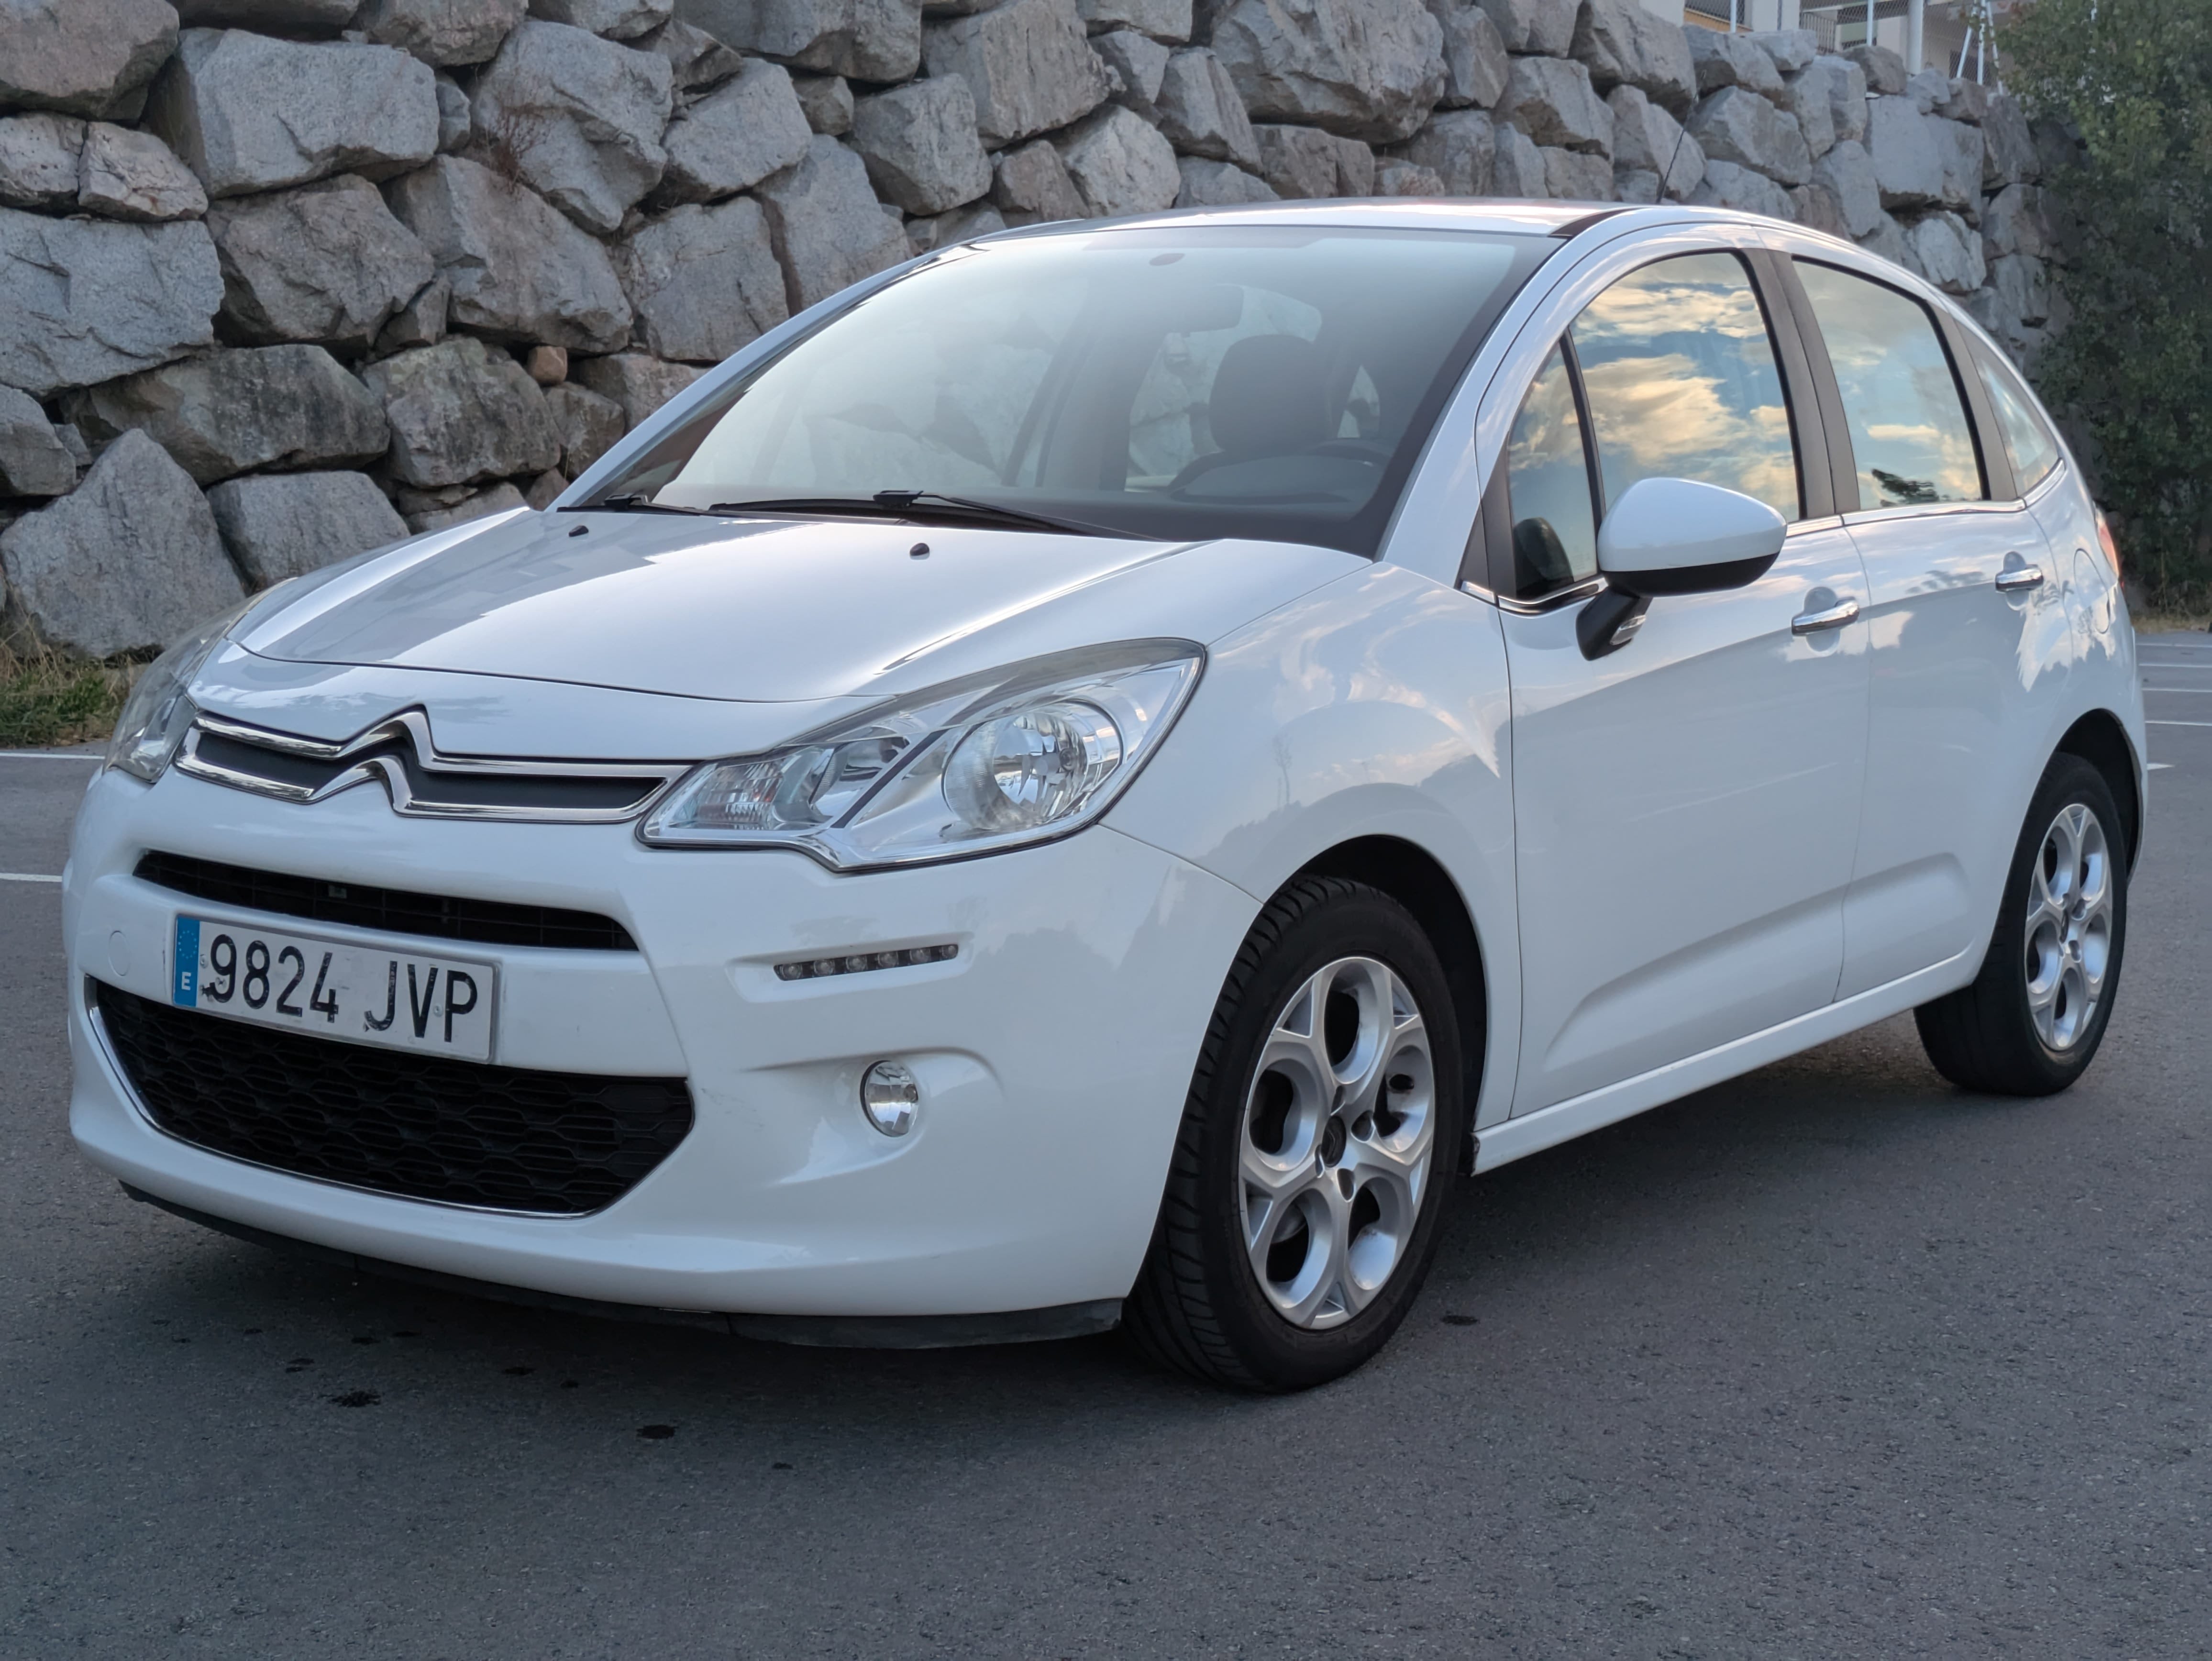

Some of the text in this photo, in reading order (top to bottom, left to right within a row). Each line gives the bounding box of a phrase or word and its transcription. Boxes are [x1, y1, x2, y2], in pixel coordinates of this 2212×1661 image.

[181, 972, 191, 991] E
[210, 933, 477, 1043] 9824 JVP
